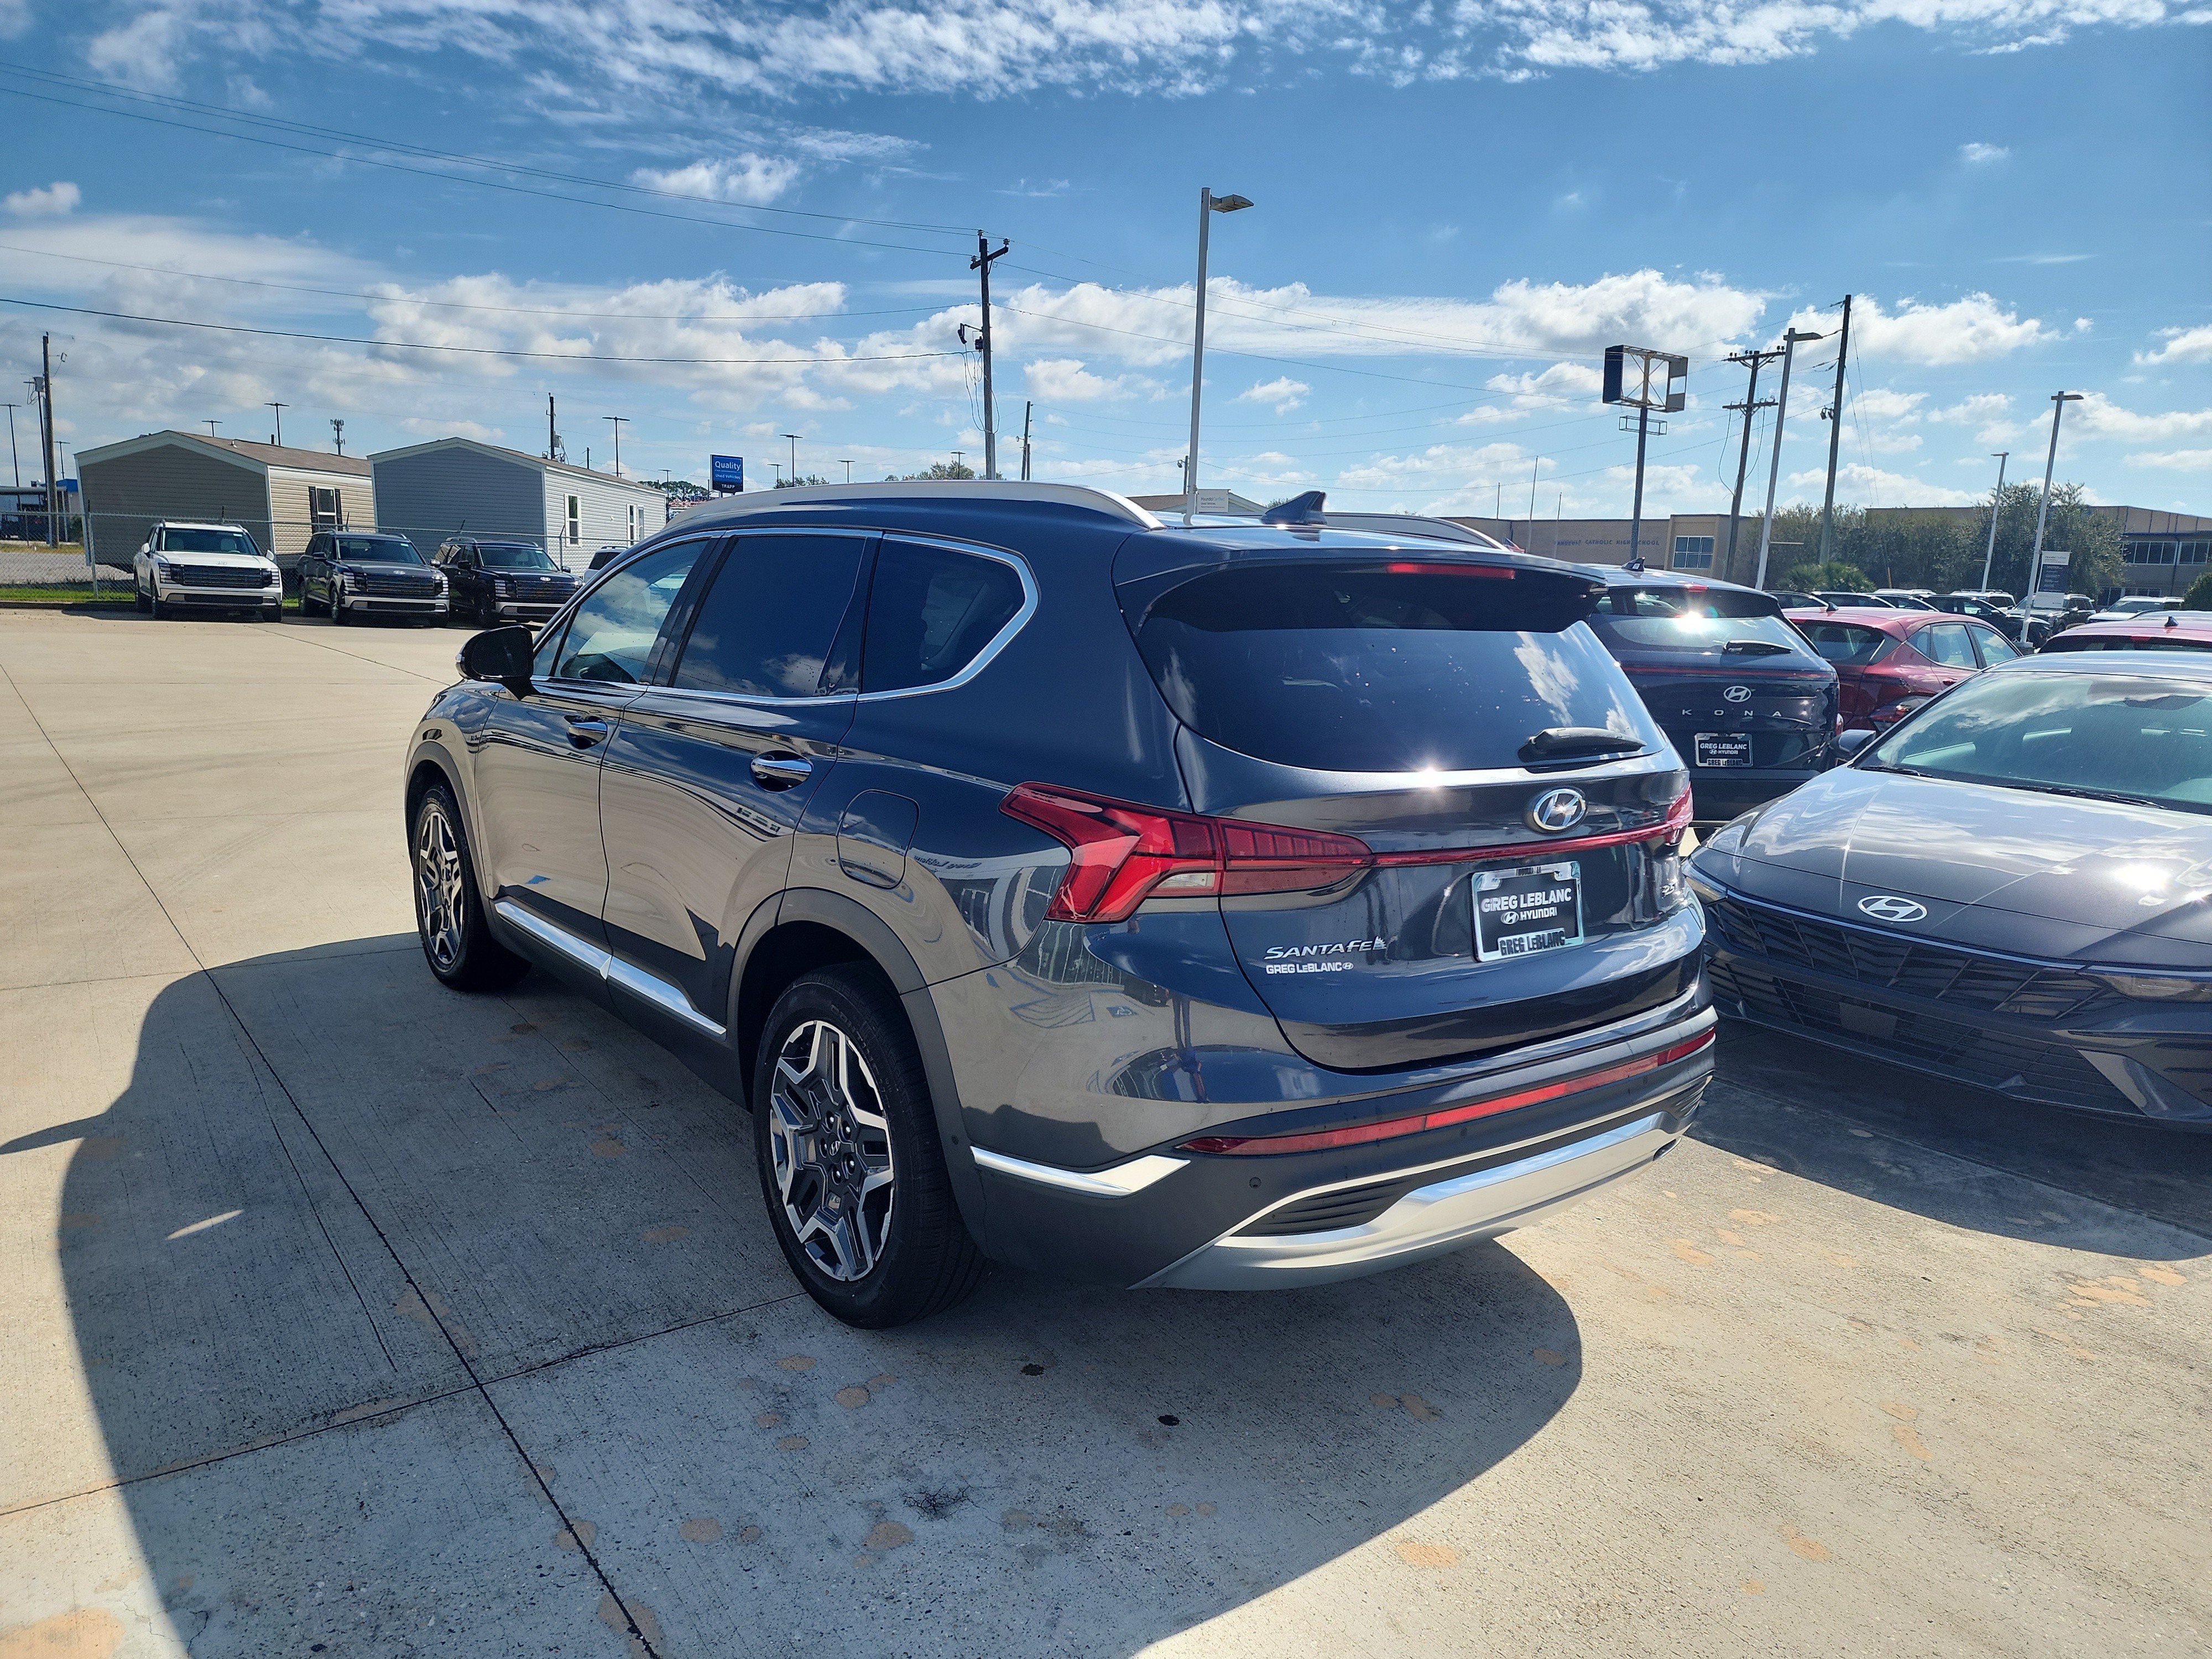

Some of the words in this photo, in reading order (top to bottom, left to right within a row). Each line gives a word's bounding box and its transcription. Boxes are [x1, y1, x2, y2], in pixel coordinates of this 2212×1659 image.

[715, 461, 741, 471] Quality
[1682, 708, 1782, 717] KONA
[1481, 895, 1519, 913] GREG
[1520, 888, 1572, 908] LEBLANC
[1520, 906, 1558, 922] HYUNDAI
[1499, 937, 1525, 956] GREG
[1266, 963, 1296, 974] GREG
